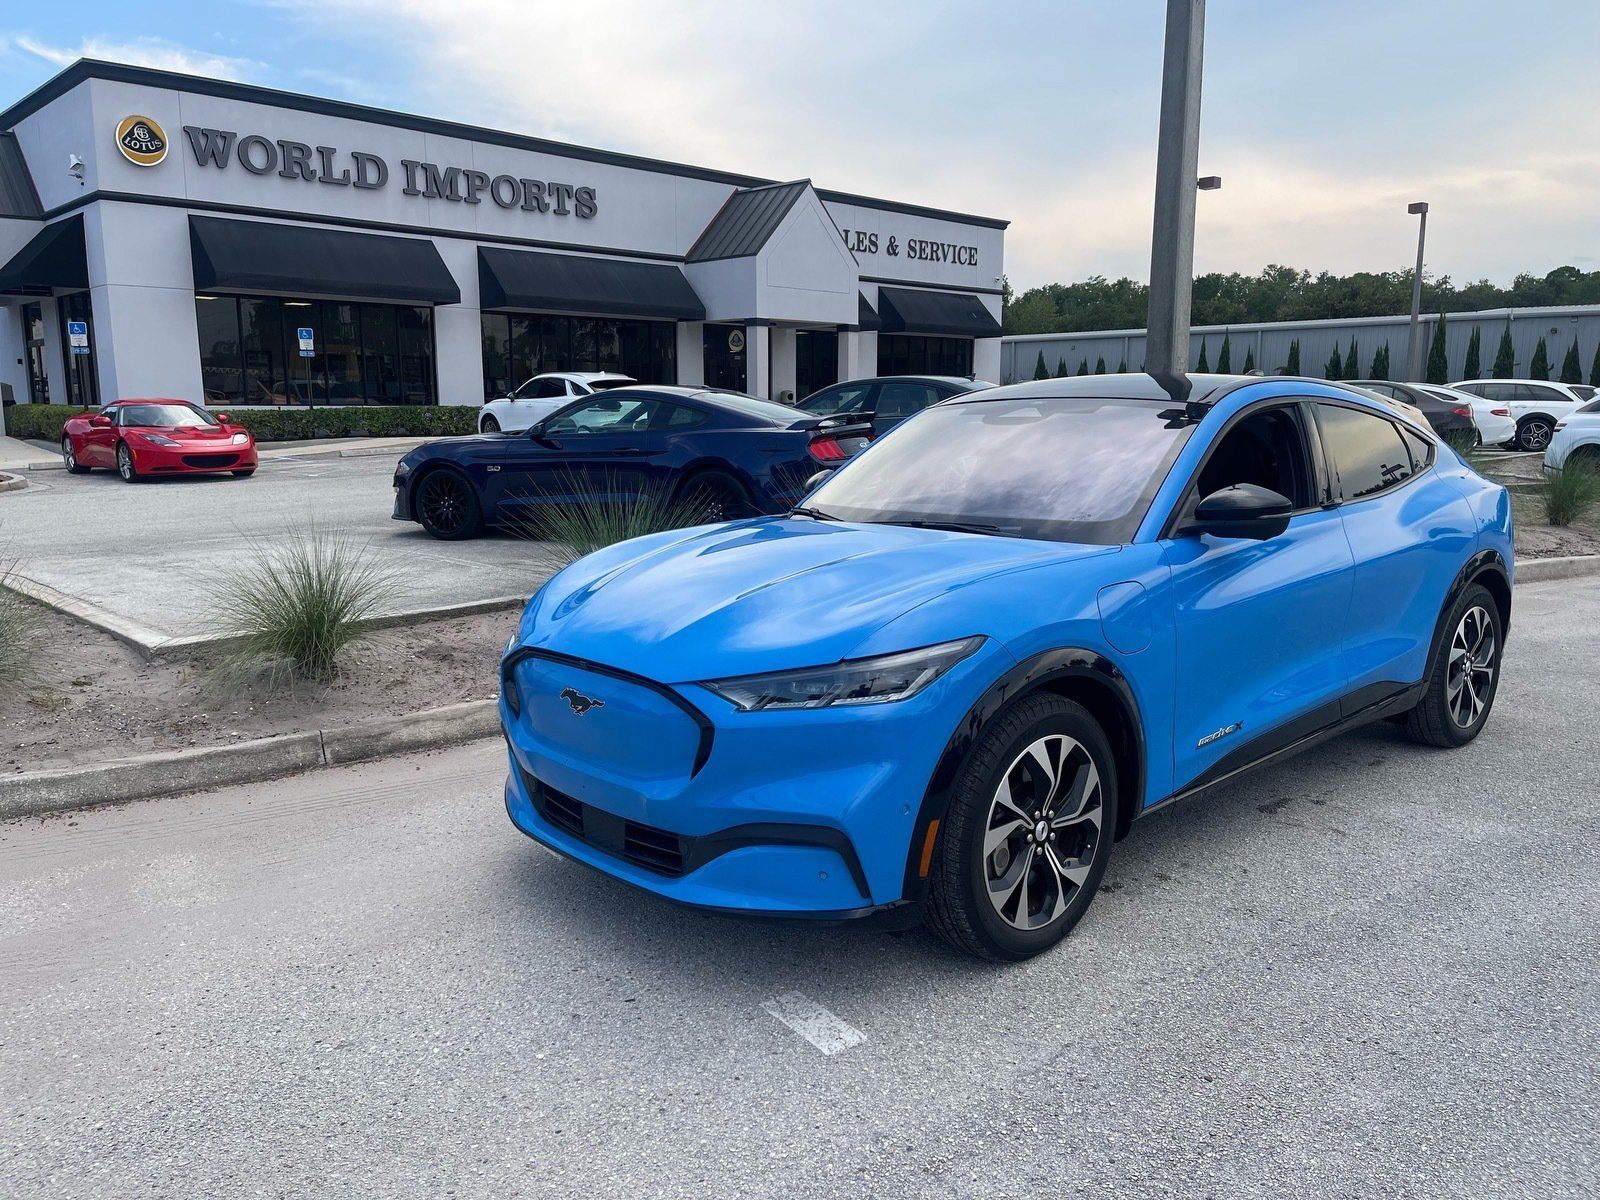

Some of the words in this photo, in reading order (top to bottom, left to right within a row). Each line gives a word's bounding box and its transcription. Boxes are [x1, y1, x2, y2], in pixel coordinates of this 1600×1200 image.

[124, 136, 162, 150] LOTUS
[183, 125, 389, 189] WORLD
[401, 159, 598, 219] IMPORTS
[886, 235, 899, 256] &
[907, 238, 978, 266] SERVICE
